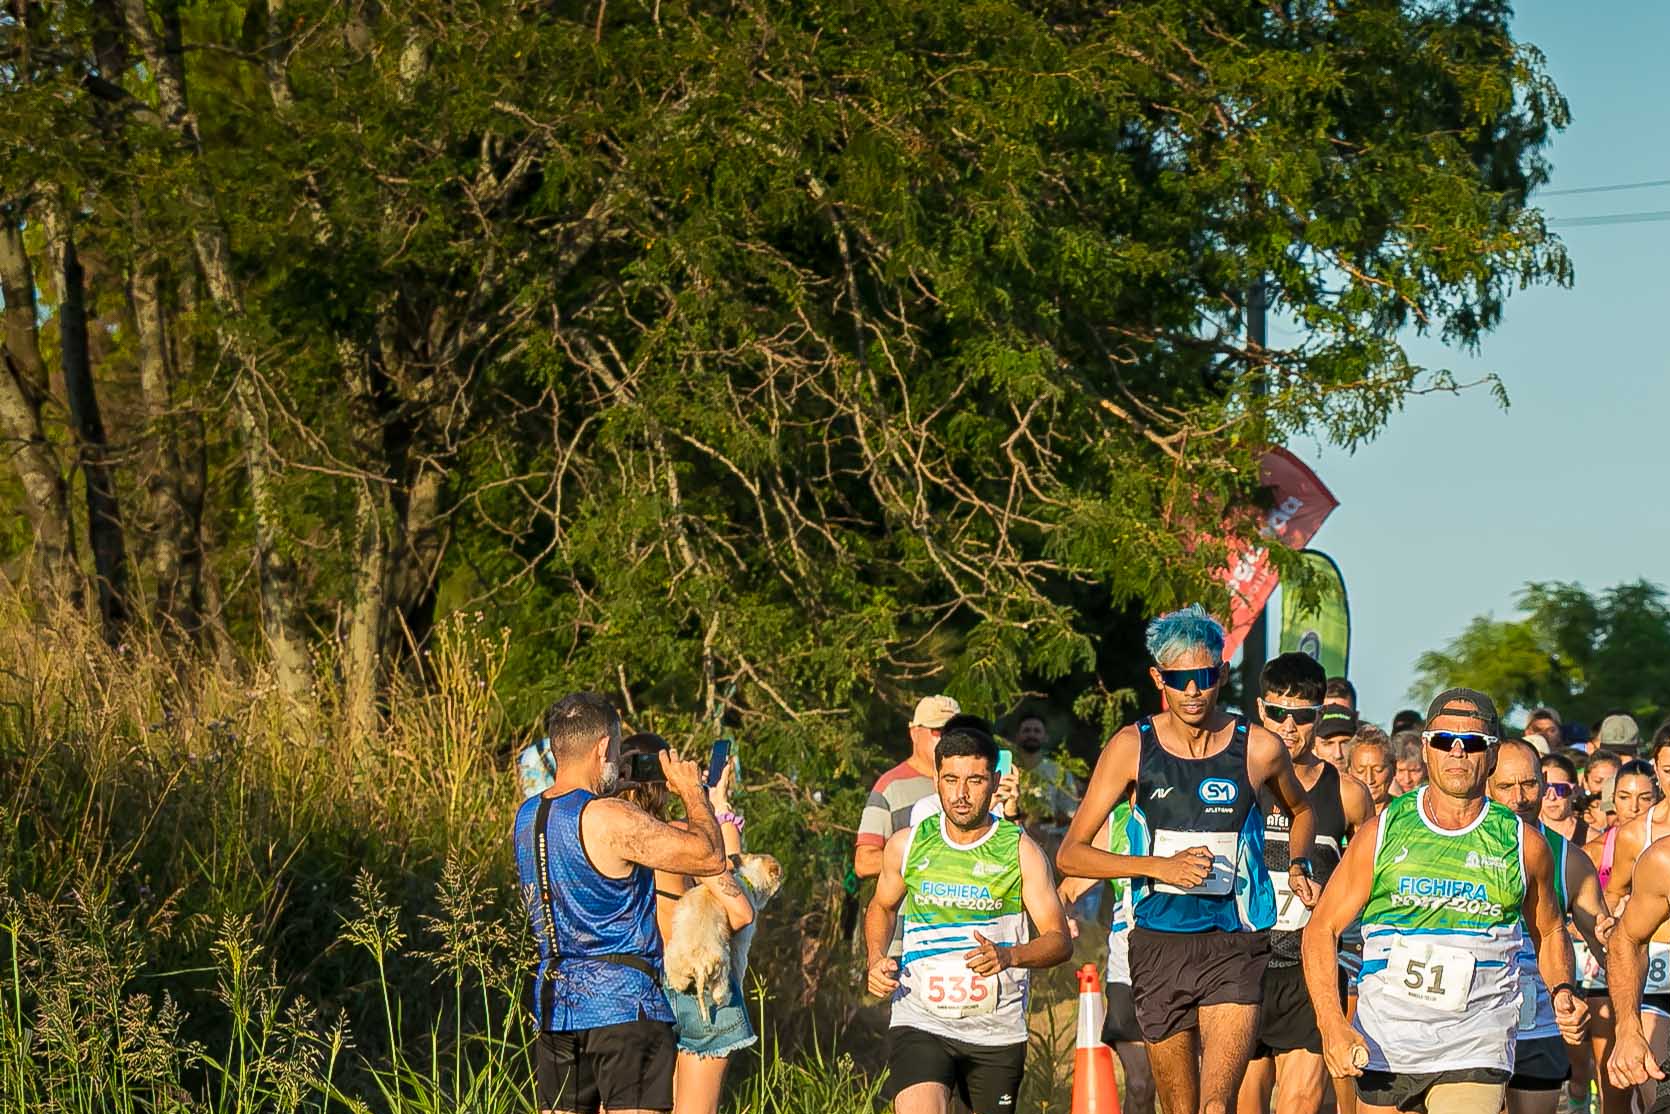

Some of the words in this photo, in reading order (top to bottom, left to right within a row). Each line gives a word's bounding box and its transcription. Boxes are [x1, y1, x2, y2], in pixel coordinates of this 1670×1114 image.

[1208, 784, 1230, 800] SM
[921, 882, 991, 899] FIGHIERA
[1399, 877, 1488, 903] FIGHIERA
[928, 975, 989, 1003] 535
[1404, 959, 1446, 995] 51
